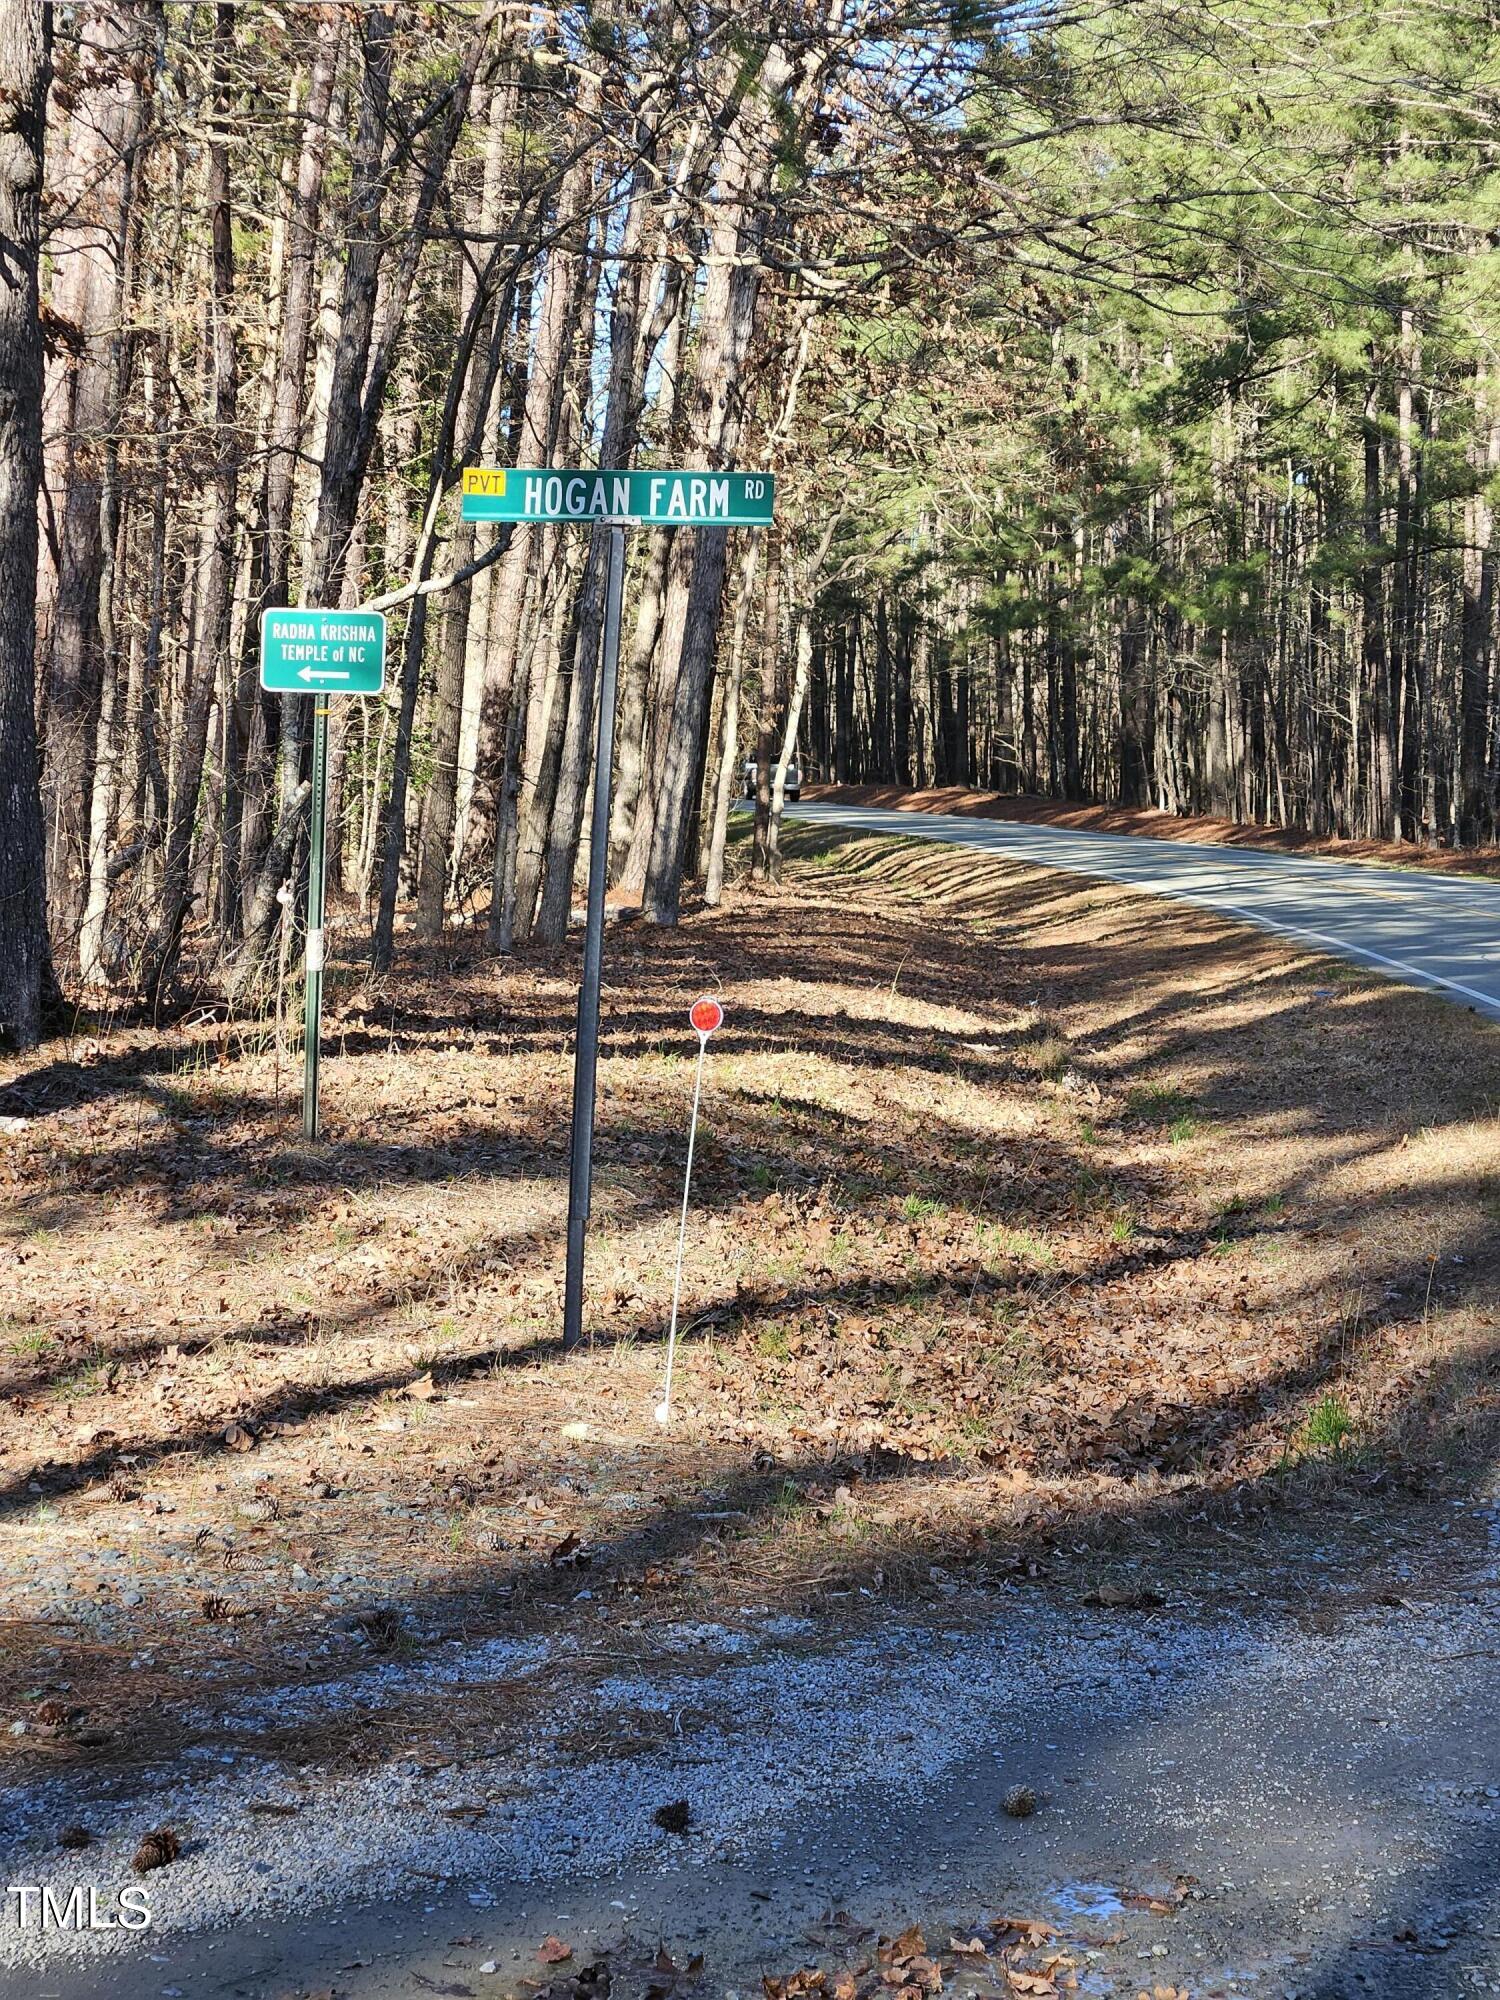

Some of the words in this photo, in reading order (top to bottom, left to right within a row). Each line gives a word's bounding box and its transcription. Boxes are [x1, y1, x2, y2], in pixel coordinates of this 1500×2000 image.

[467, 475, 501, 494] PVT
[524, 476, 631, 516] HOGAN
[649, 478, 730, 517] FARM
[744, 479, 765, 500] RD
[272, 622, 316, 641] RADHA
[320, 624, 377, 642] KRISHNA
[281, 644, 329, 662] TEMPLE
[332, 645, 345, 663] of
[348, 646, 366, 663] NC
